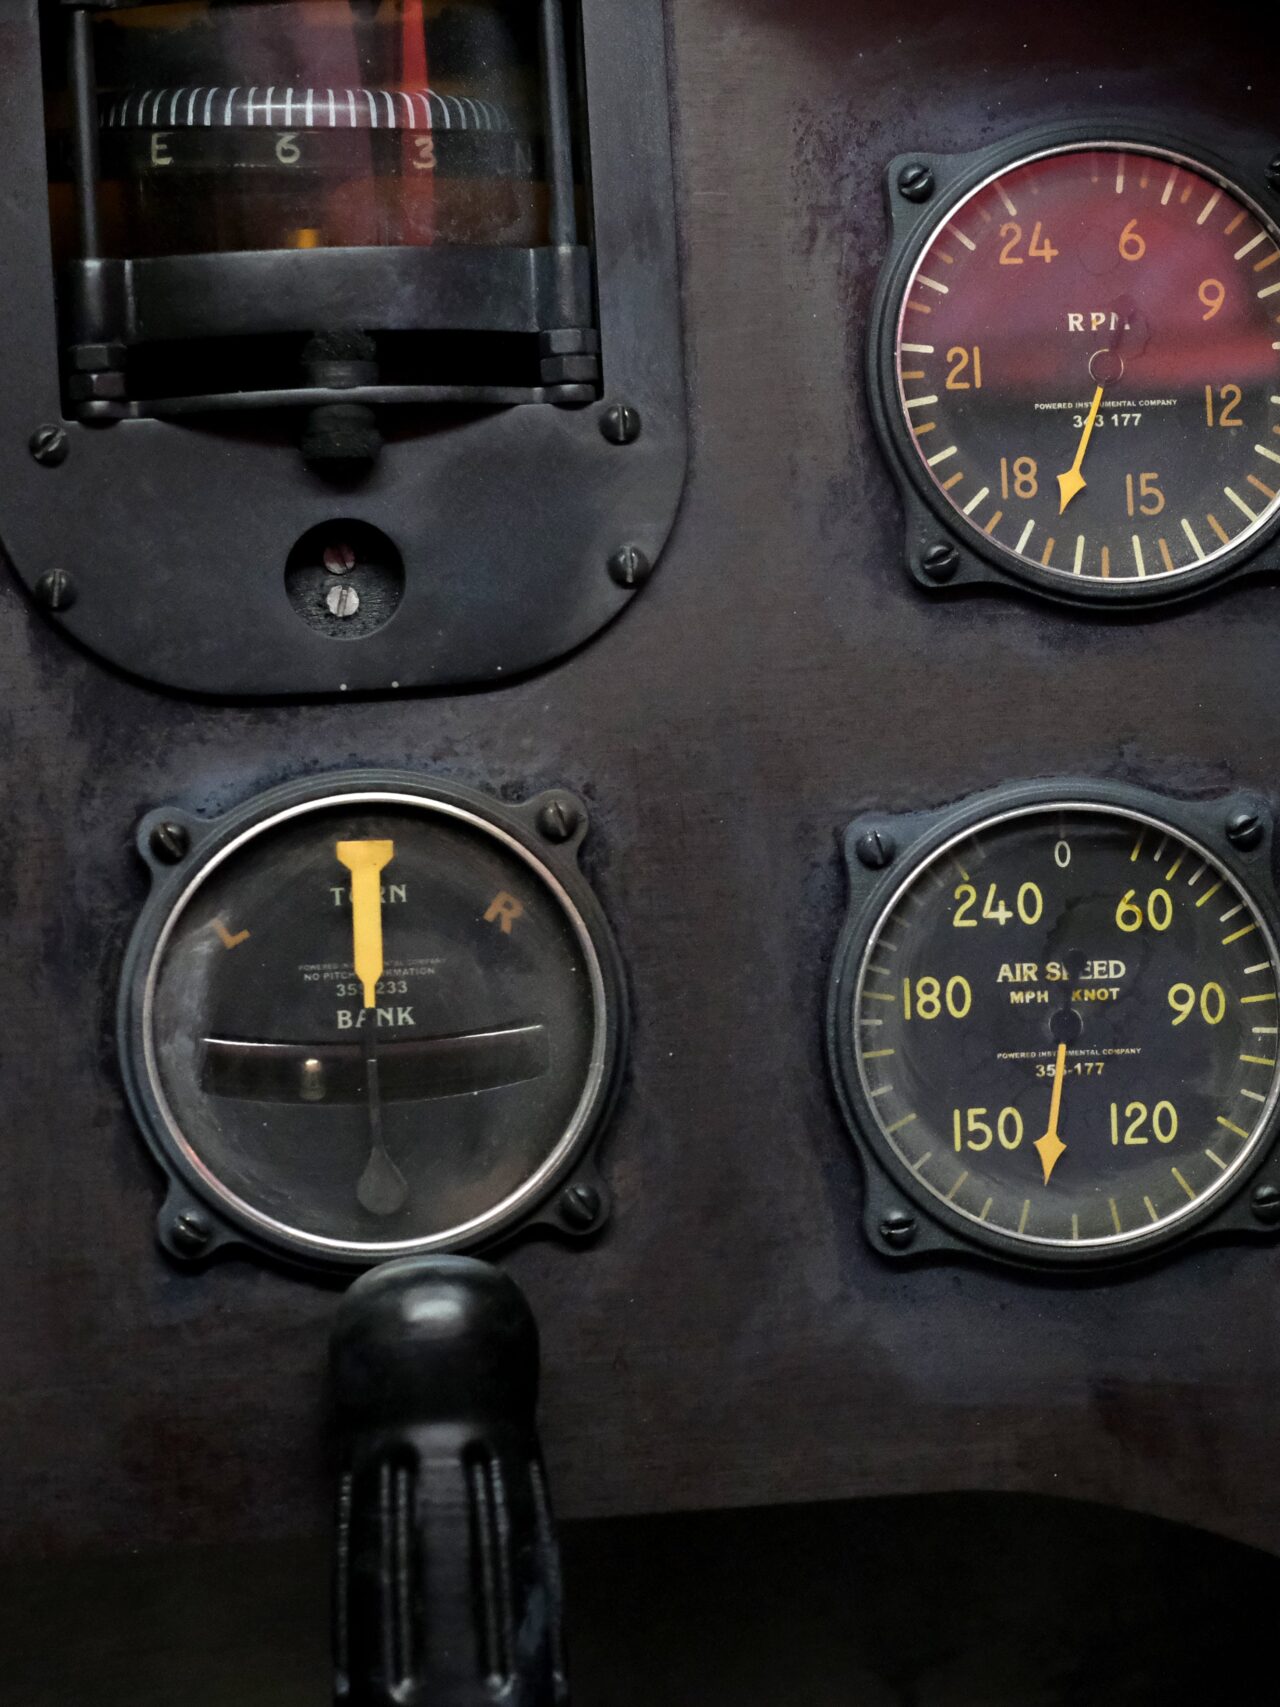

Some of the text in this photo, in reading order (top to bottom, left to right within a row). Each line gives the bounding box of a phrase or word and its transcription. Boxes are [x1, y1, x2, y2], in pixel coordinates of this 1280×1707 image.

[150, 132, 174, 167] E
[275, 133, 301, 164] 6
[413, 134, 437, 170] 3
[999, 221, 1059, 265] 24
[1118, 218, 1146, 261] 6
[1198, 279, 1225, 321] 9
[945, 346, 982, 390] 21
[1034, 399, 1178, 411] POWERED INSTMENTAL COMPANY
[1072, 413, 1142, 428] 33 177
[1205, 384, 1243, 427] 12
[1000, 456, 1038, 499] 18
[1125, 472, 1166, 516] 15
[1054, 840, 1071, 868] 0
[482, 890, 525, 935] R
[952, 881, 1044, 928] 240
[1115, 888, 1174, 932] 60
[210, 918, 251, 950] L
[304, 972, 320, 982] NO
[996, 962, 1038, 983] AIR
[903, 975, 973, 1020] 180
[1010, 988, 1120, 1004] MPH KNOT
[1167, 981, 1227, 1027] 90
[997, 1051, 1037, 1060] POWERED
[1102, 1047, 1142, 1056] COMPANY
[953, 1106, 1025, 1153] 150
[1110, 1099, 1179, 1146] 120
